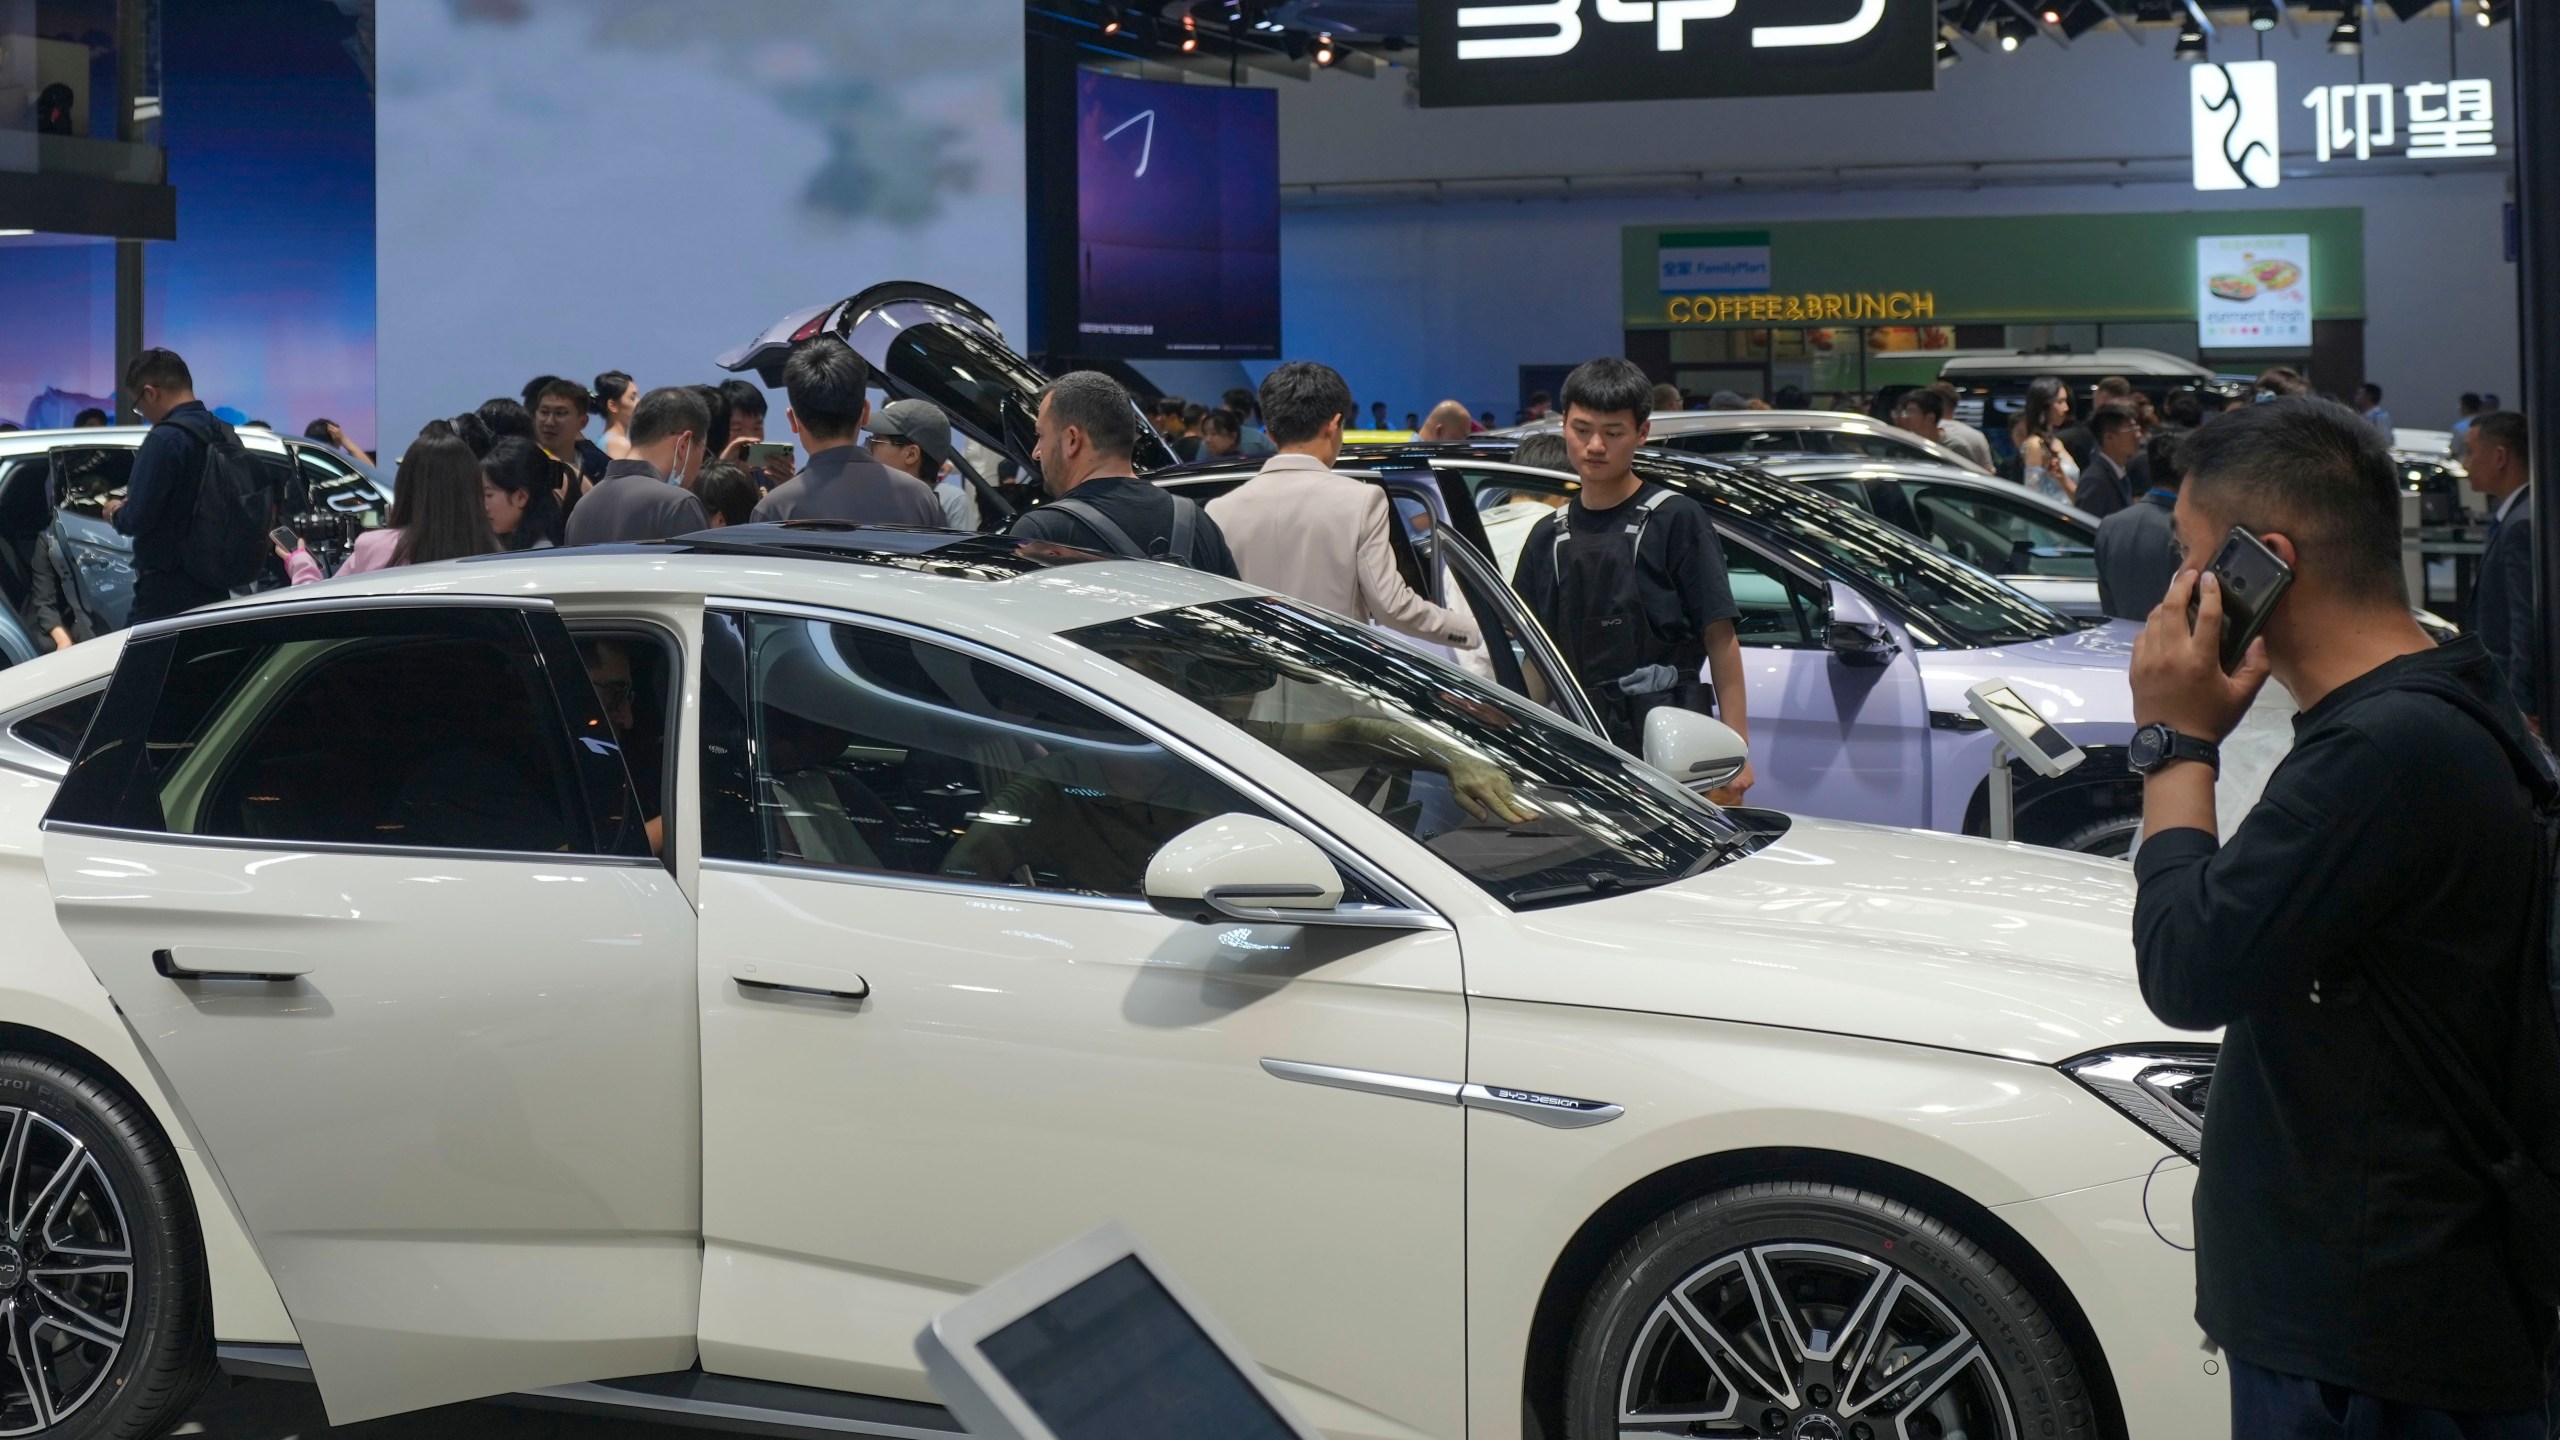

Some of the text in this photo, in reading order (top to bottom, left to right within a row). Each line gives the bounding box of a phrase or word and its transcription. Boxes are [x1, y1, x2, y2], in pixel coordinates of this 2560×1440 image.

[2302, 78, 2497, 162] 仰望
[1662, 261, 1766, 276] 全家 FamilyMart
[1667, 291, 1934, 323] COFFEE&BRUNCH
[1499, 1090, 1579, 1108] BYD DESIGN
[1909, 1239, 2036, 1377] GitiControl
